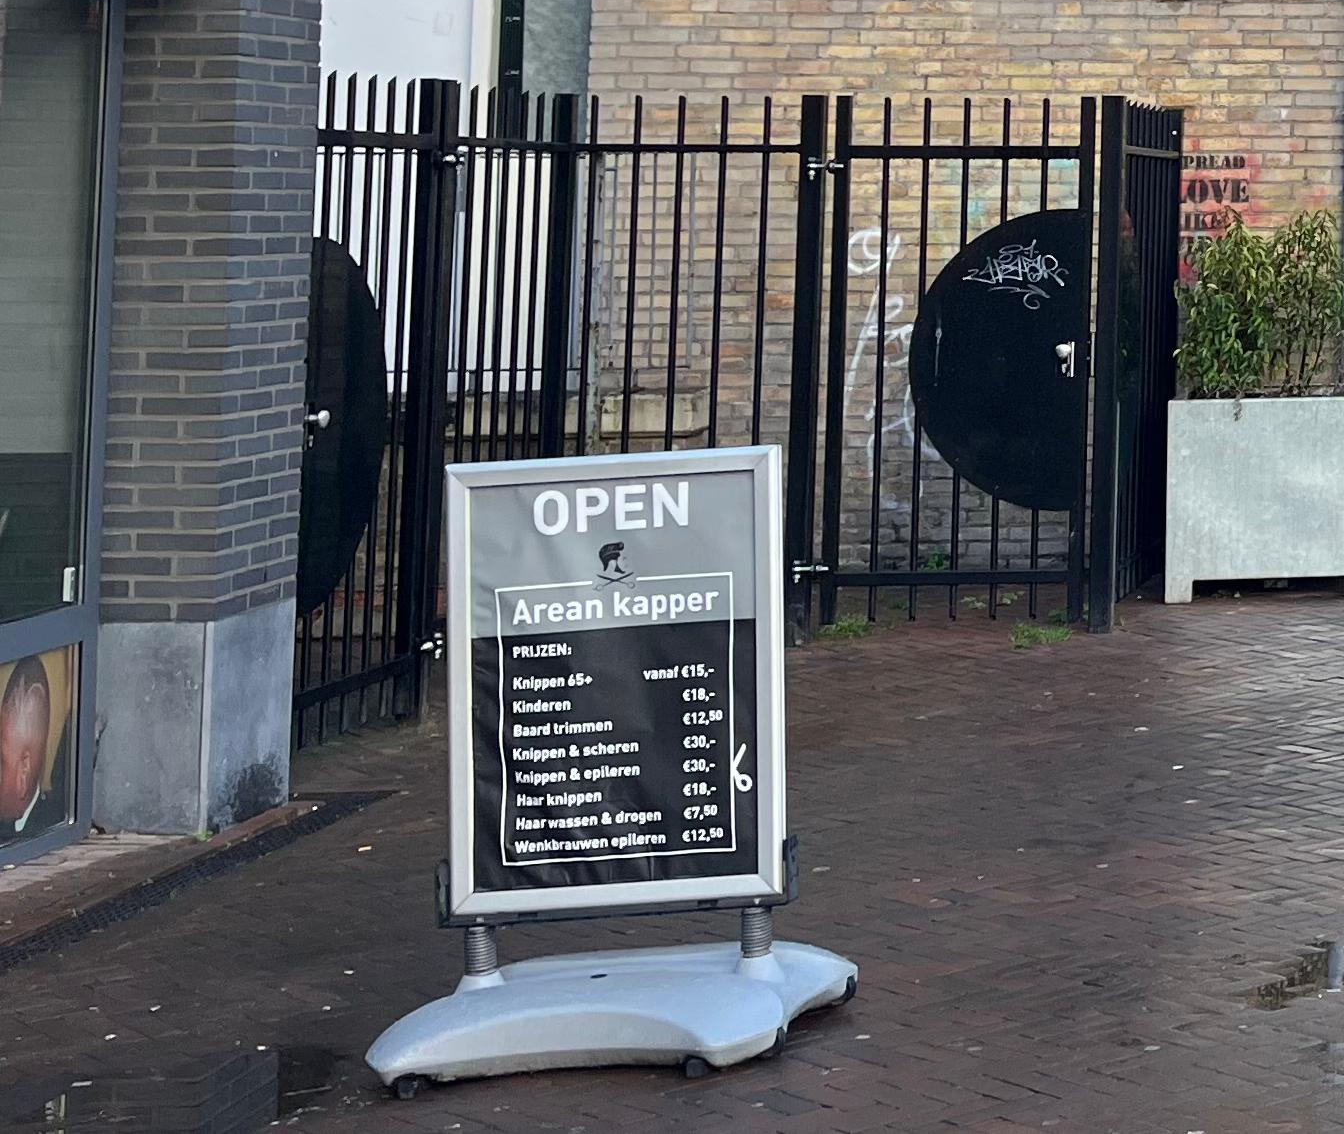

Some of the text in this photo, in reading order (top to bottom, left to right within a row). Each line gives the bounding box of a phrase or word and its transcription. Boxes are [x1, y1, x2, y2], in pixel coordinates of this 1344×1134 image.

[1181, 155, 1246, 170] PREAD
[1181, 178, 1249, 204] OVE
[533, 481, 689, 536] OPEN
[512, 590, 719, 625] Arean kapper
[512, 643, 572, 658] PRIJZEN:
[512, 676, 565, 691] Knippen
[567, 672, 593, 687] 65+
[643, 665, 679, 680] vanaf
[512, 699, 572, 714] Kinderen
[513, 710, 723, 737] Baard trimmen €12,50
[512, 746, 566, 762] Knippen
[569, 744, 580, 757] &
[583, 741, 639, 757] scheren
[515, 770, 566, 786] Knippen
[570, 768, 581, 781] &
[584, 765, 640, 781] epileren
[516, 793, 544, 806] Haar
[547, 790, 602, 807] knippen
[515, 804, 718, 830] Haar wassen & drogen €7,50
[515, 827, 724, 854] Wenkbrauwen epileren €12,50
